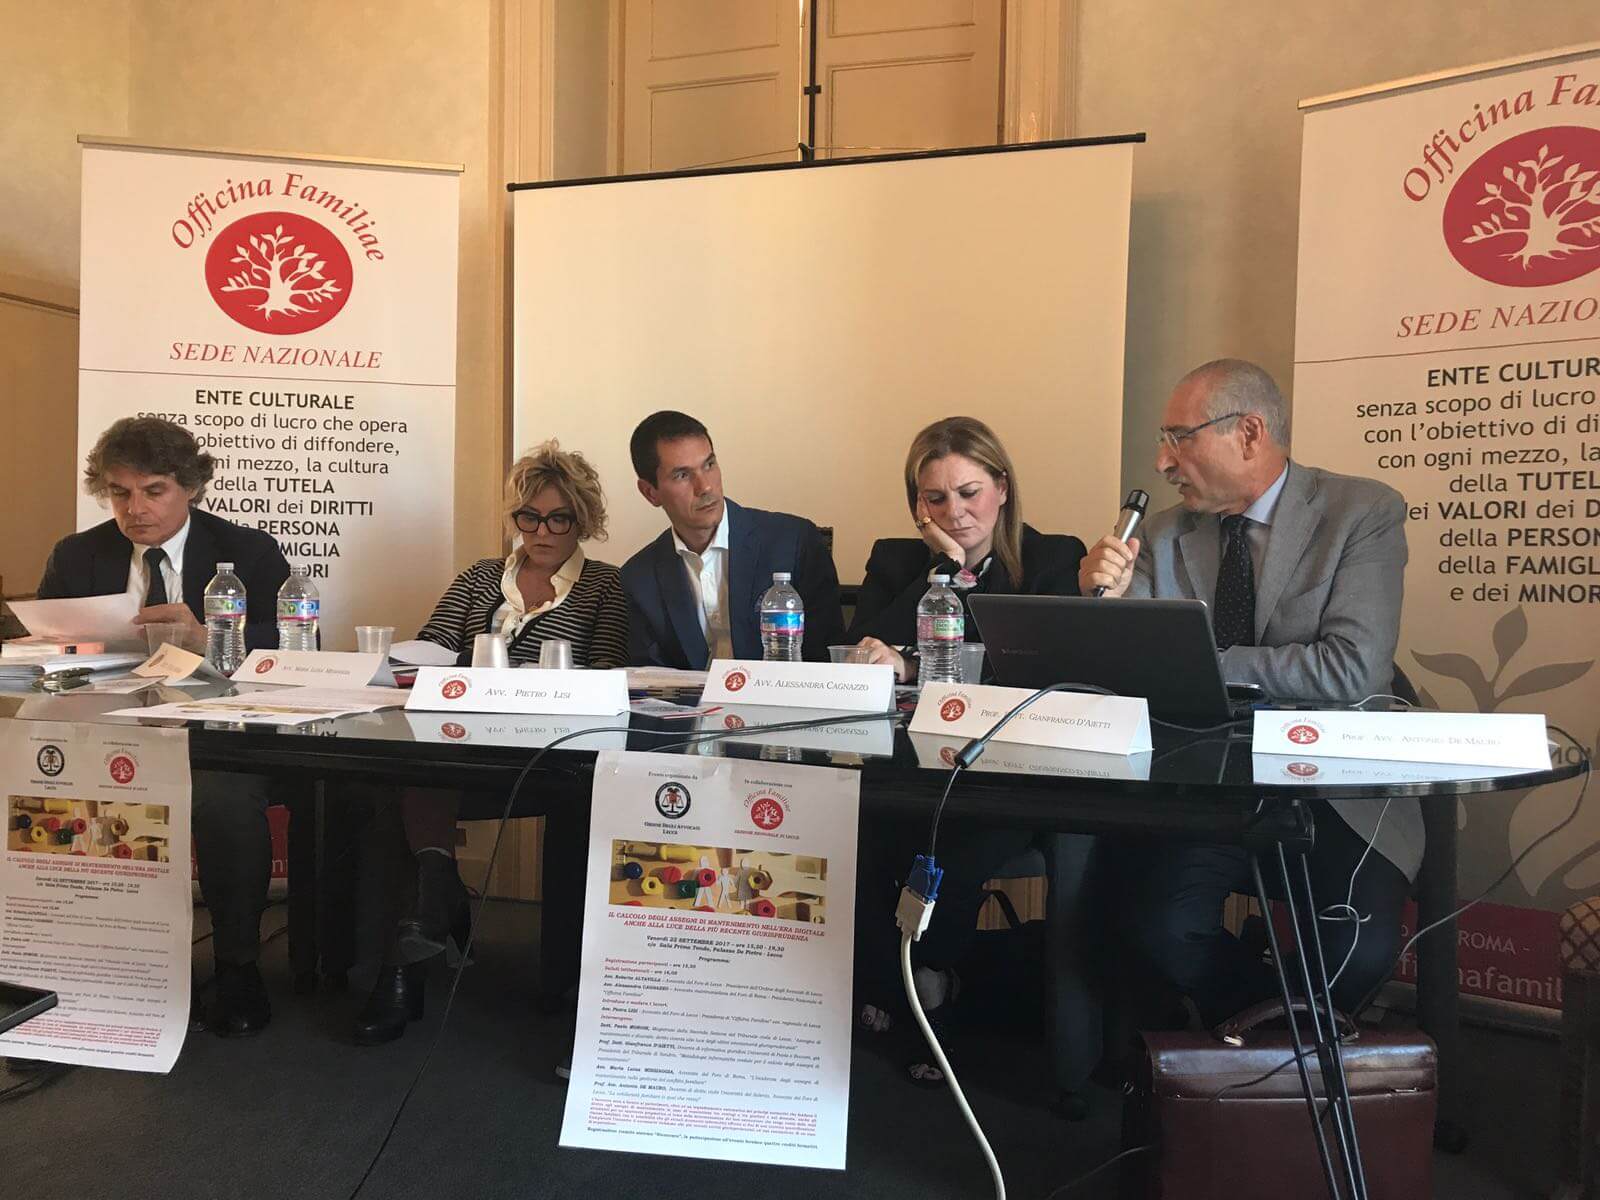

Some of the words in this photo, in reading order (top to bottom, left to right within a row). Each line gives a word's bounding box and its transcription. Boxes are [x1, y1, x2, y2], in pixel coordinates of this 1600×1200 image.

[1403, 89, 1536, 202] Officina
[1547, 74, 1600, 106] Fa
[172, 175, 273, 252] Officina
[282, 172, 386, 263] Familiae
[1397, 308, 1482, 338] SEDE
[1490, 297, 1600, 329] NAZIO
[169, 341, 237, 364] SEDE
[242, 345, 383, 370] NAZIONALE
[1427, 366, 1490, 388] ENTE
[195, 389, 244, 406] ENTE
[249, 392, 355, 410] CULTURALE
[1356, 401, 1417, 418] senza
[1425, 396, 1491, 416] scopo
[1500, 391, 1522, 410] di
[1532, 388, 1596, 408] lucro
[194, 413, 245, 431] scopo
[250, 412, 267, 428] di
[272, 413, 317, 430] lucro
[323, 416, 353, 431] che
[359, 418, 409, 437] opera
[1364, 427, 1402, 443] con
[1543, 416, 1566, 435] di
[197, 432, 275, 449] obiettivo
[281, 433, 298, 450] di
[303, 434, 400, 456] diffondere,
[237, 458, 299, 474] mezzo,
[306, 458, 322, 473] la
[328, 459, 389, 474] cultura
[1377, 453, 1416, 470] con
[1424, 448, 1472, 471] ogni
[1482, 447, 1568, 466] mezzo,
[1580, 442, 1600, 462] la
[213, 476, 257, 492] della
[263, 478, 335, 494] TUTELA
[1450, 473, 1507, 493] della
[205, 497, 271, 513] VALORI
[277, 499, 303, 515] dei
[310, 501, 375, 517] DIRITTI
[1438, 501, 1526, 520] VALORI
[1536, 499, 1574, 518] dei
[1585, 500, 1600, 518] D
[257, 520, 340, 536] PERSONA
[1439, 528, 1497, 547] della
[279, 541, 340, 557] MIGLIA
[1438, 556, 1496, 575] della
[1450, 587, 1464, 601] e
[1472, 583, 1509, 602] dei
[1458, 930, 1517, 954] ROMA
